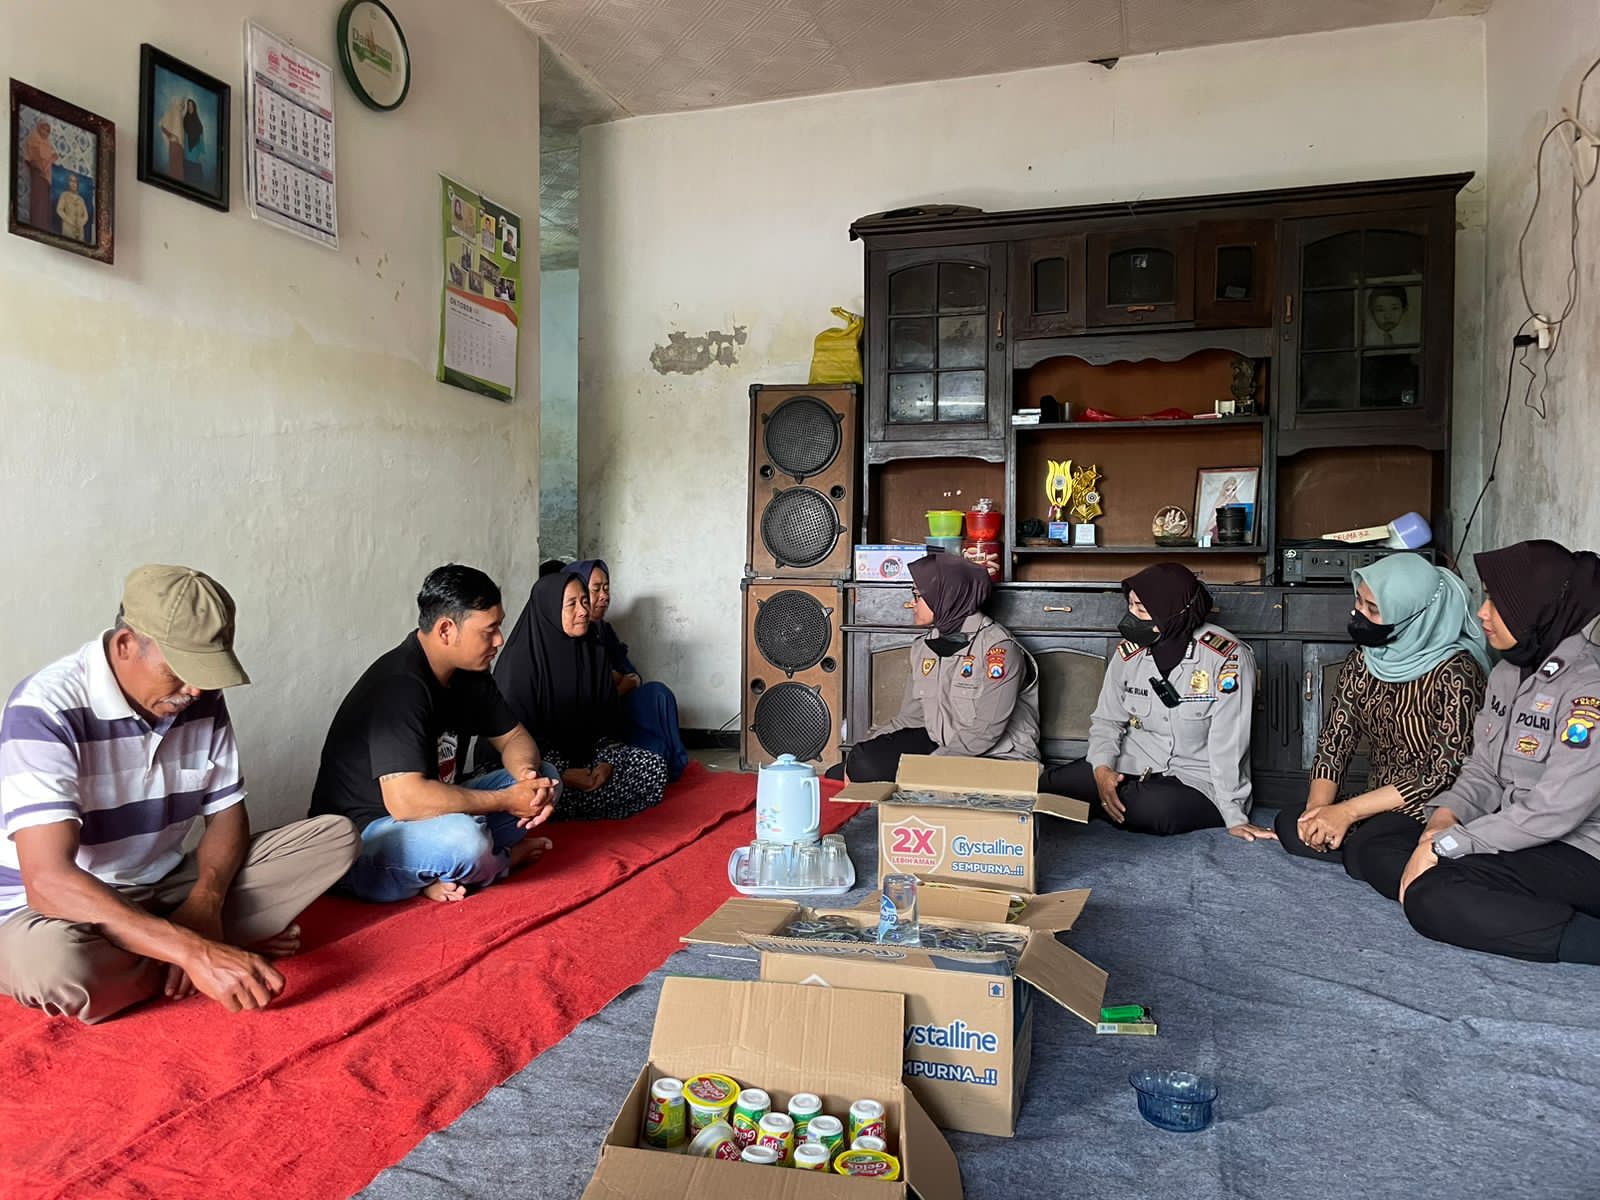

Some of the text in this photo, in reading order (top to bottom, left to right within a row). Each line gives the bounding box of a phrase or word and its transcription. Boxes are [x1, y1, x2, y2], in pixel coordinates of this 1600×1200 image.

[1516, 712, 1550, 730] POLRI
[892, 827, 936, 856] 2X
[952, 862, 1024, 876] SEMPURNA..!!
